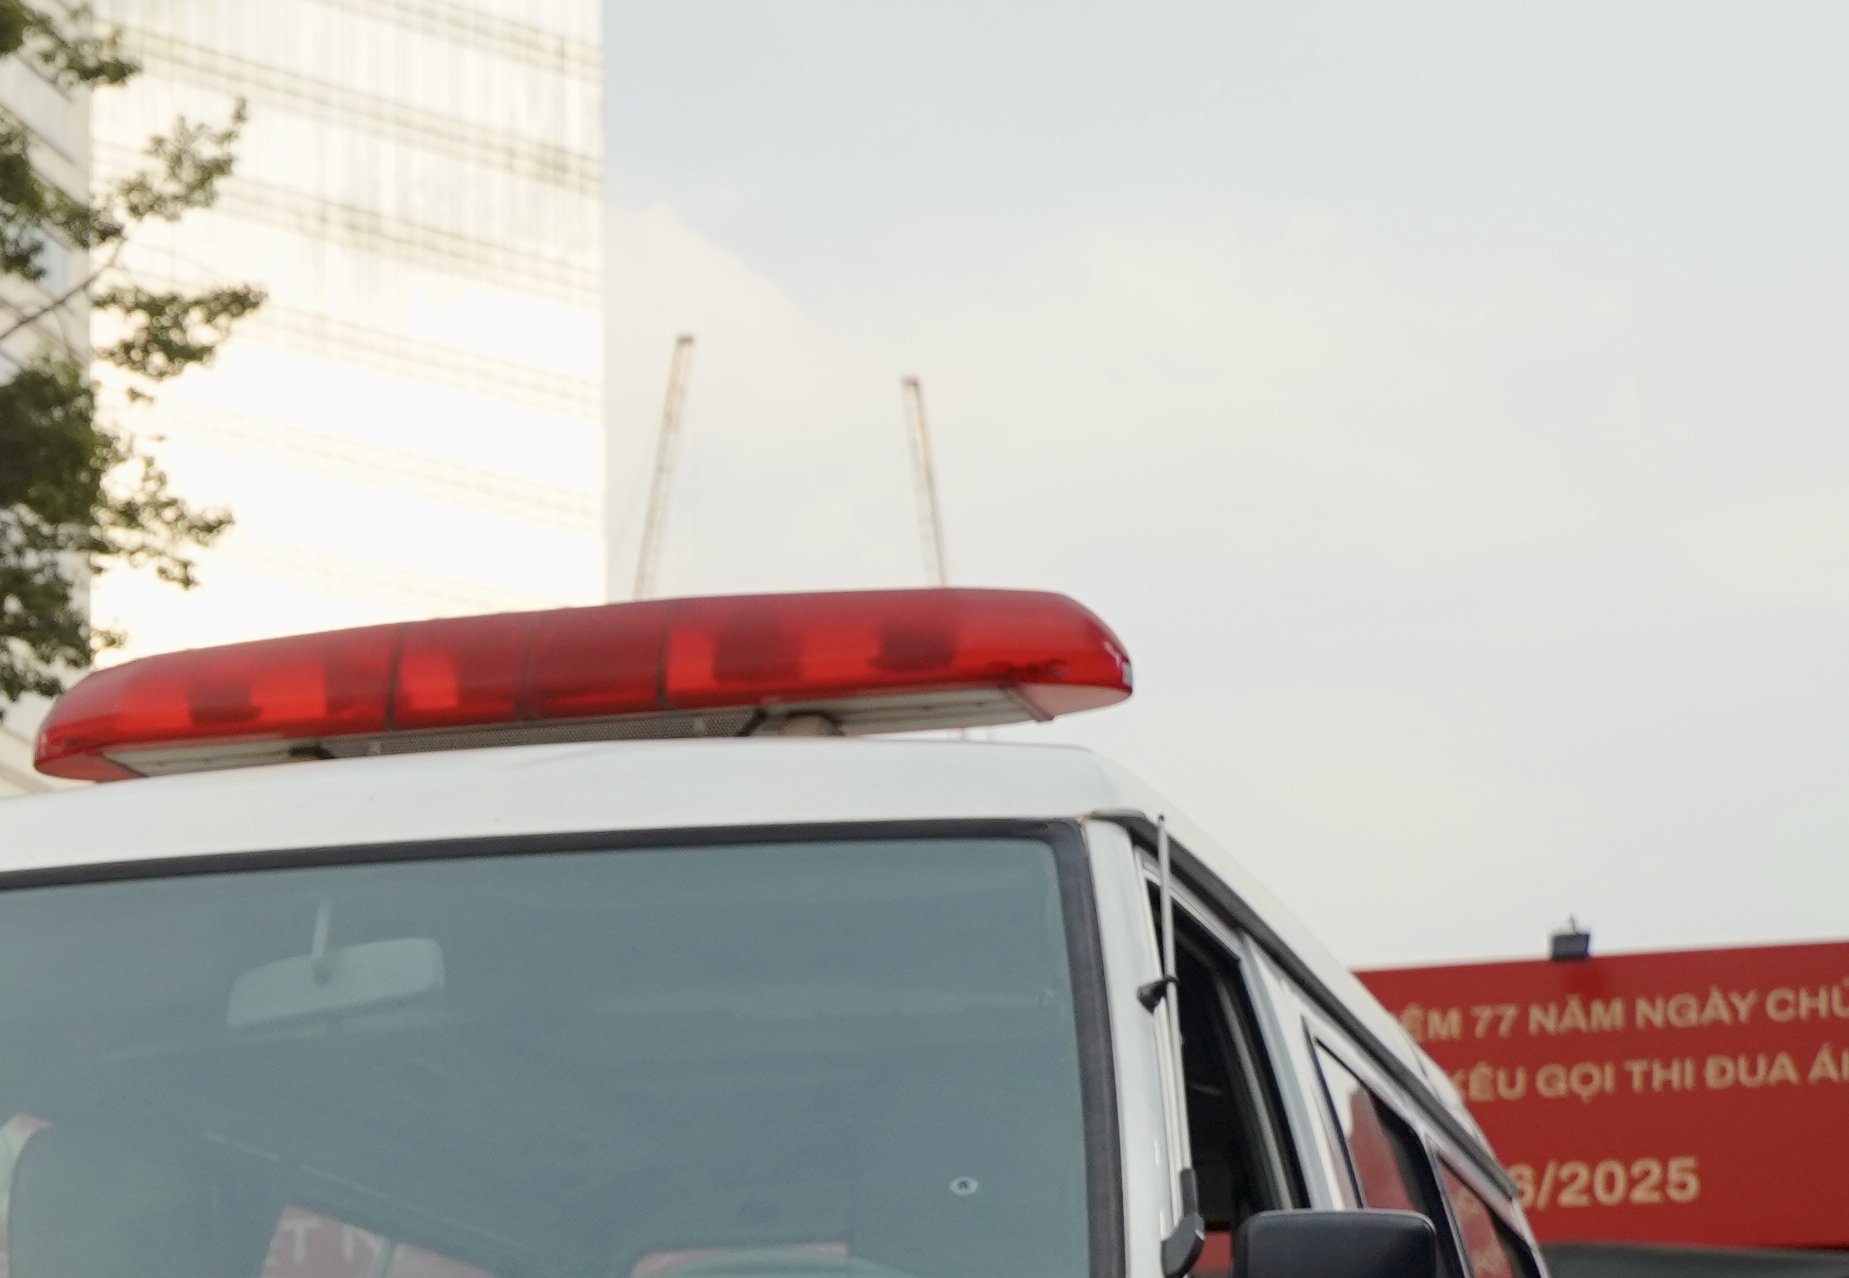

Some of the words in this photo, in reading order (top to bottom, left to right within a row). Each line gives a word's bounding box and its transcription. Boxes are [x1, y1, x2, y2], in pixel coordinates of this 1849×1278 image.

[1470, 1003, 1518, 1039] 77
[1527, 993, 1625, 1036] NĂM
[1635, 984, 1760, 1029] NGÀY
[1535, 1061, 1617, 1104] GỌI
[1622, 1056, 1695, 1093] THI
